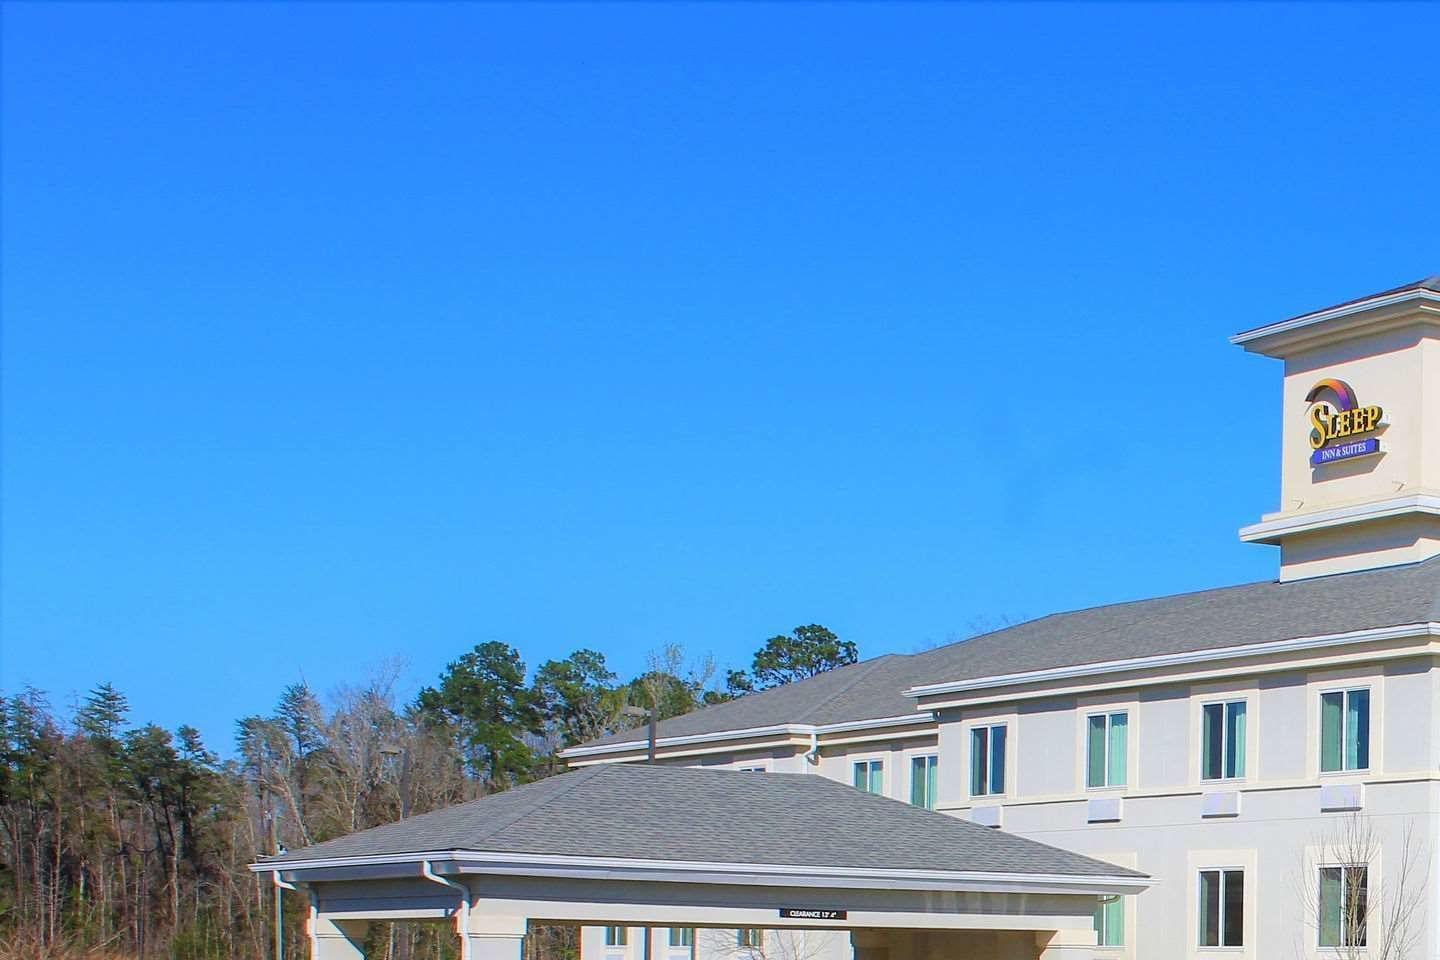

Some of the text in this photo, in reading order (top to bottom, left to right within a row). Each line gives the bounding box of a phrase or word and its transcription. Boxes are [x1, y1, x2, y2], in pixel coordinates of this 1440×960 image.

[1310, 404, 1381, 449] SLEEP
[1322, 442, 1367, 459] INN & SUITES
[790, 910, 821, 918] CLEARANCE
